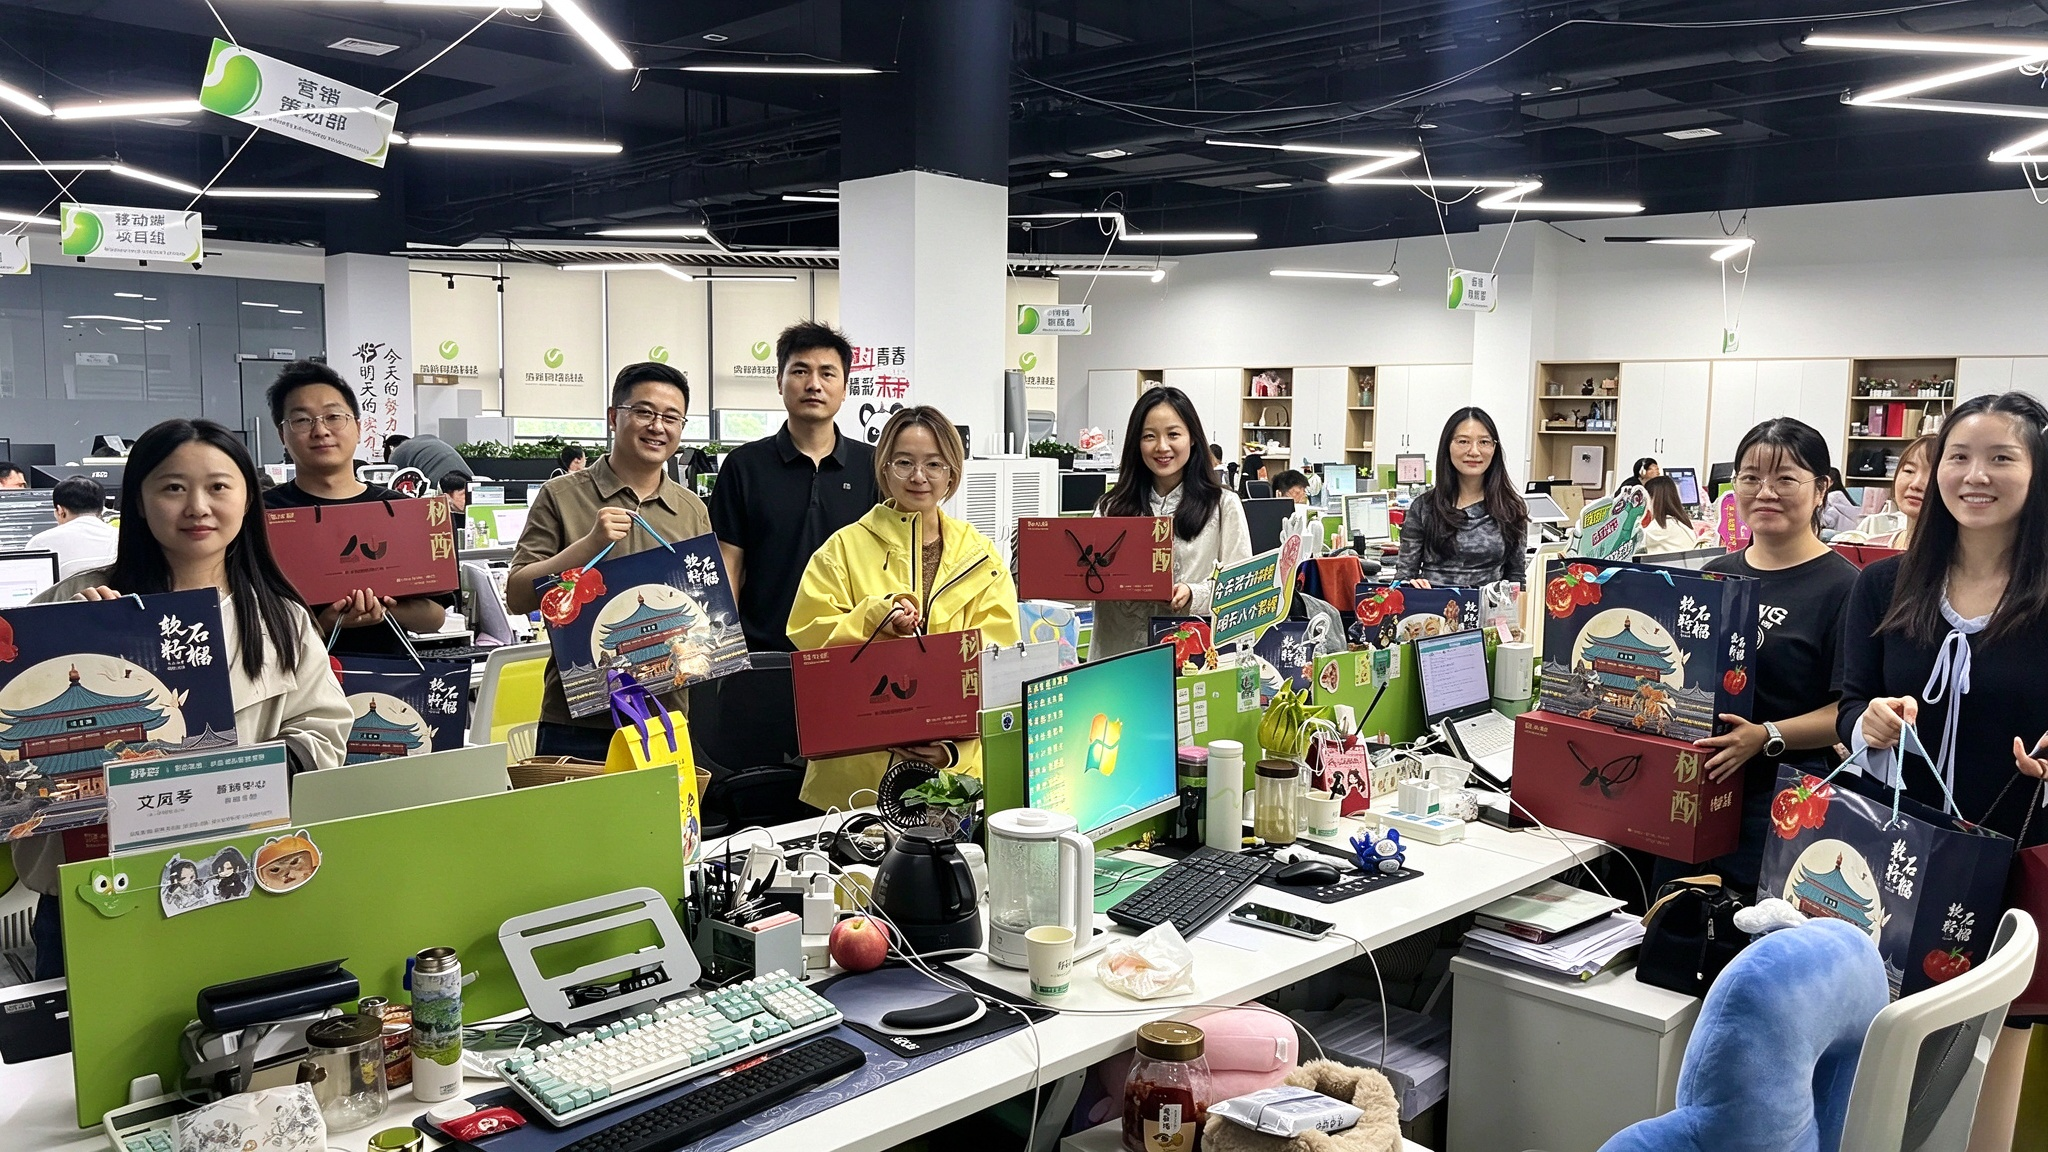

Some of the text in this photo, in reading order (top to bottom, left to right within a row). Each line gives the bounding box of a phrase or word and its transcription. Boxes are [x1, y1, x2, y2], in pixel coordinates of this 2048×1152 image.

[298, 77, 341, 106] 营销
[279, 95, 348, 131] 策划部
[115, 212, 165, 228] 移动端
[116, 230, 166, 245] 项目组
[383, 348, 402, 433] 今天的努力
